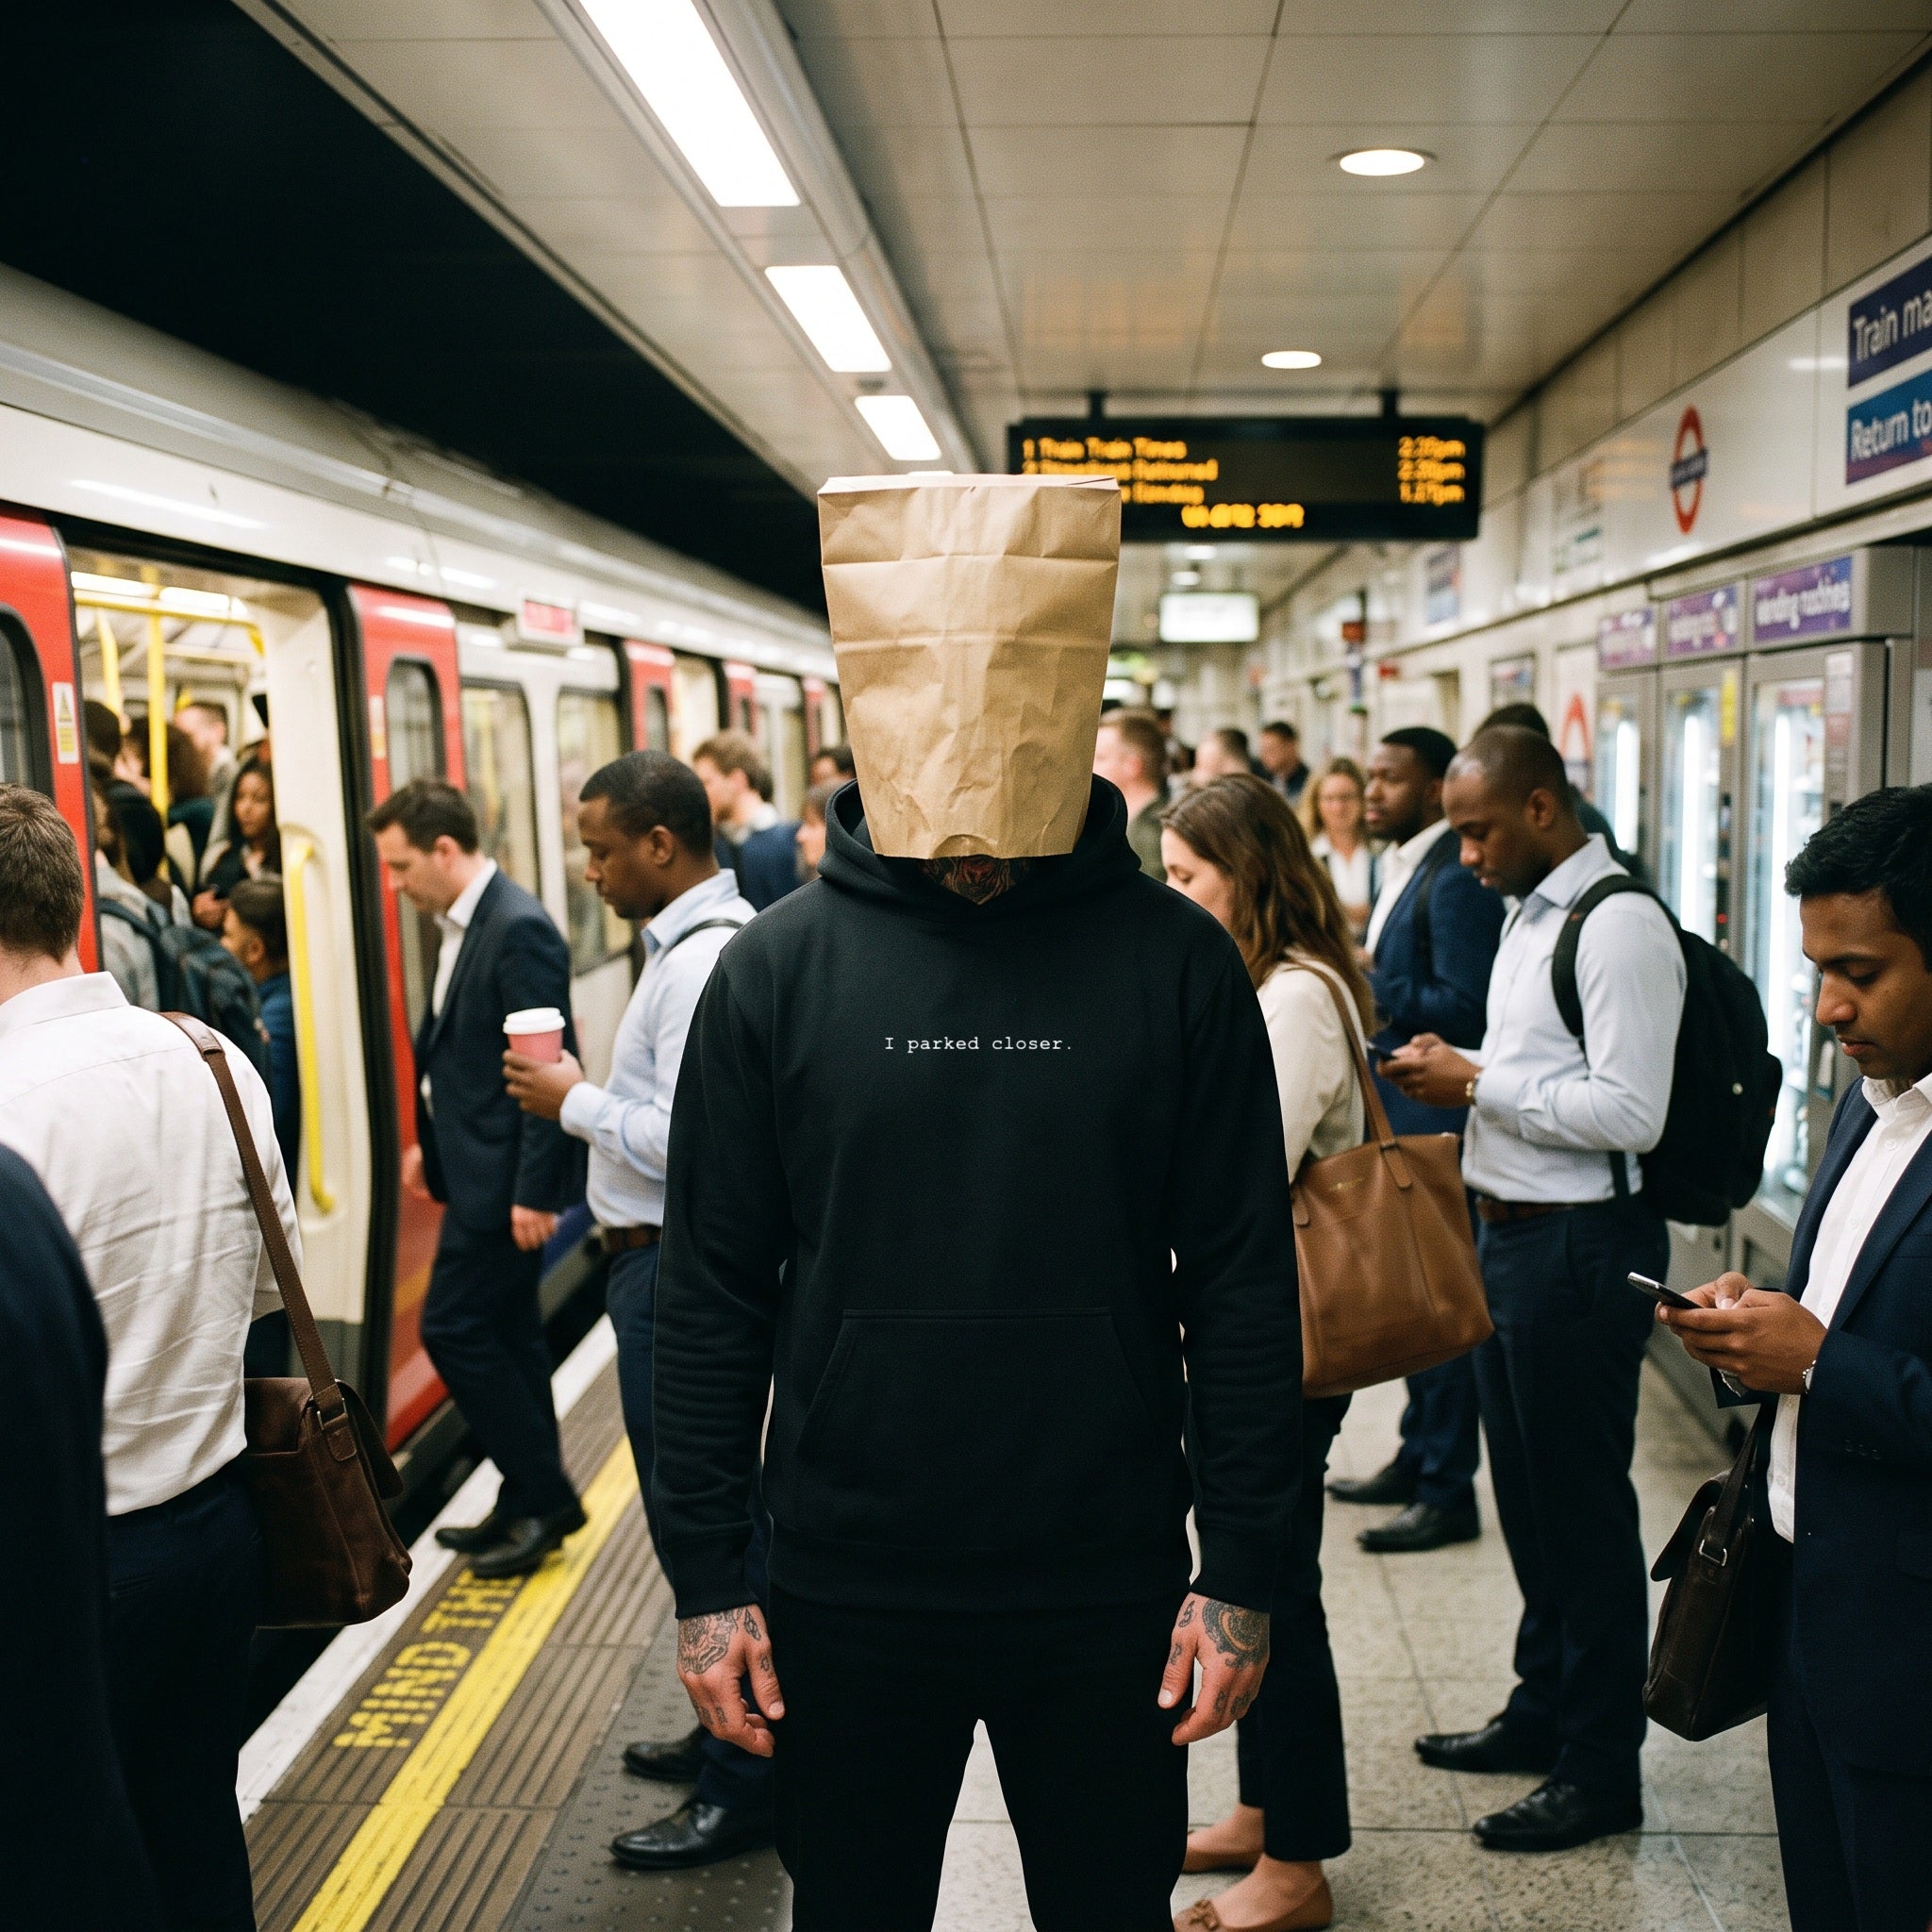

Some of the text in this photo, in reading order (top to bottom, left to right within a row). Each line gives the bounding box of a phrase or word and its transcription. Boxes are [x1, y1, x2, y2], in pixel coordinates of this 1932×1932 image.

[1853, 305, 1899, 363] Train
[1851, 408, 1909, 463] Return
[885, 1036, 1072, 1054] I parked closer.
[332, 1641, 472, 1747] MIND
